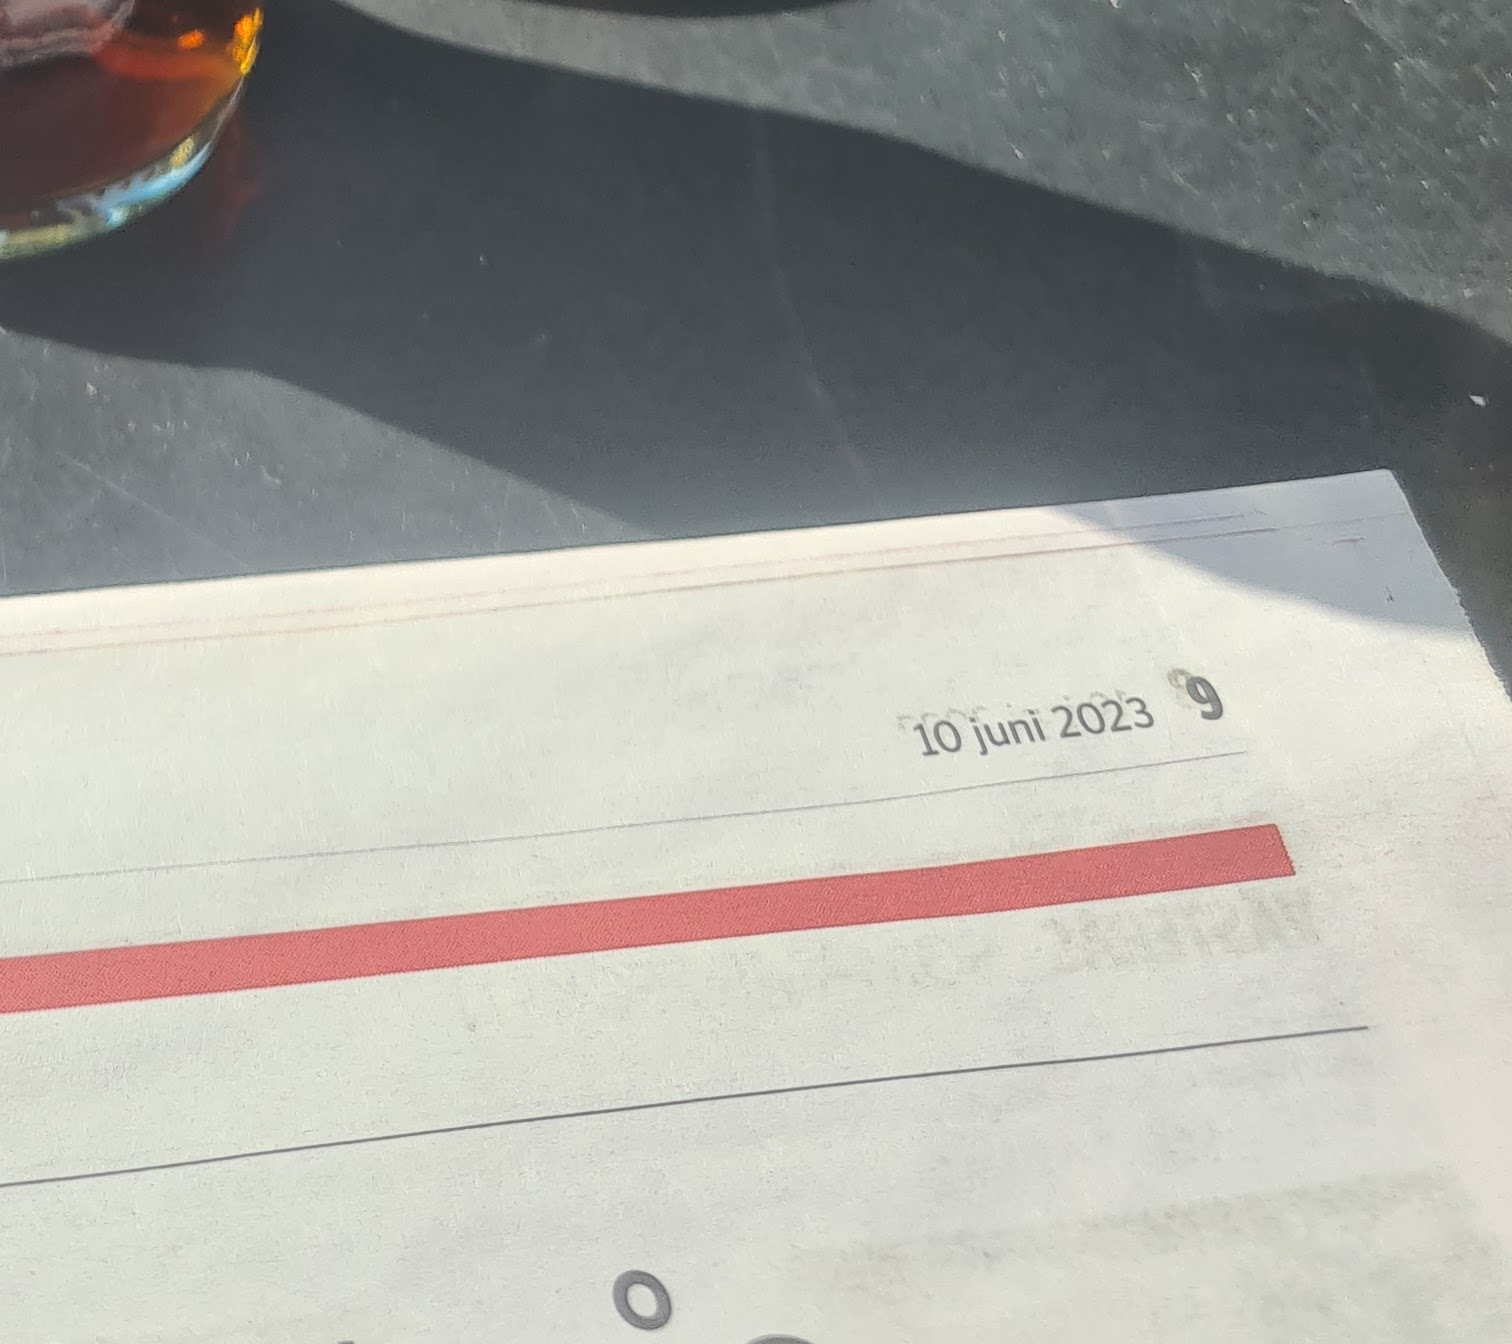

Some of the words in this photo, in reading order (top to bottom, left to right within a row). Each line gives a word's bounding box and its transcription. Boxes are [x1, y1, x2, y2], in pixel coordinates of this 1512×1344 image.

[913, 718, 963, 756] 10
[969, 709, 1046, 755] juni
[1051, 696, 1155, 740] 2023
[1187, 675, 1224, 721] 9
